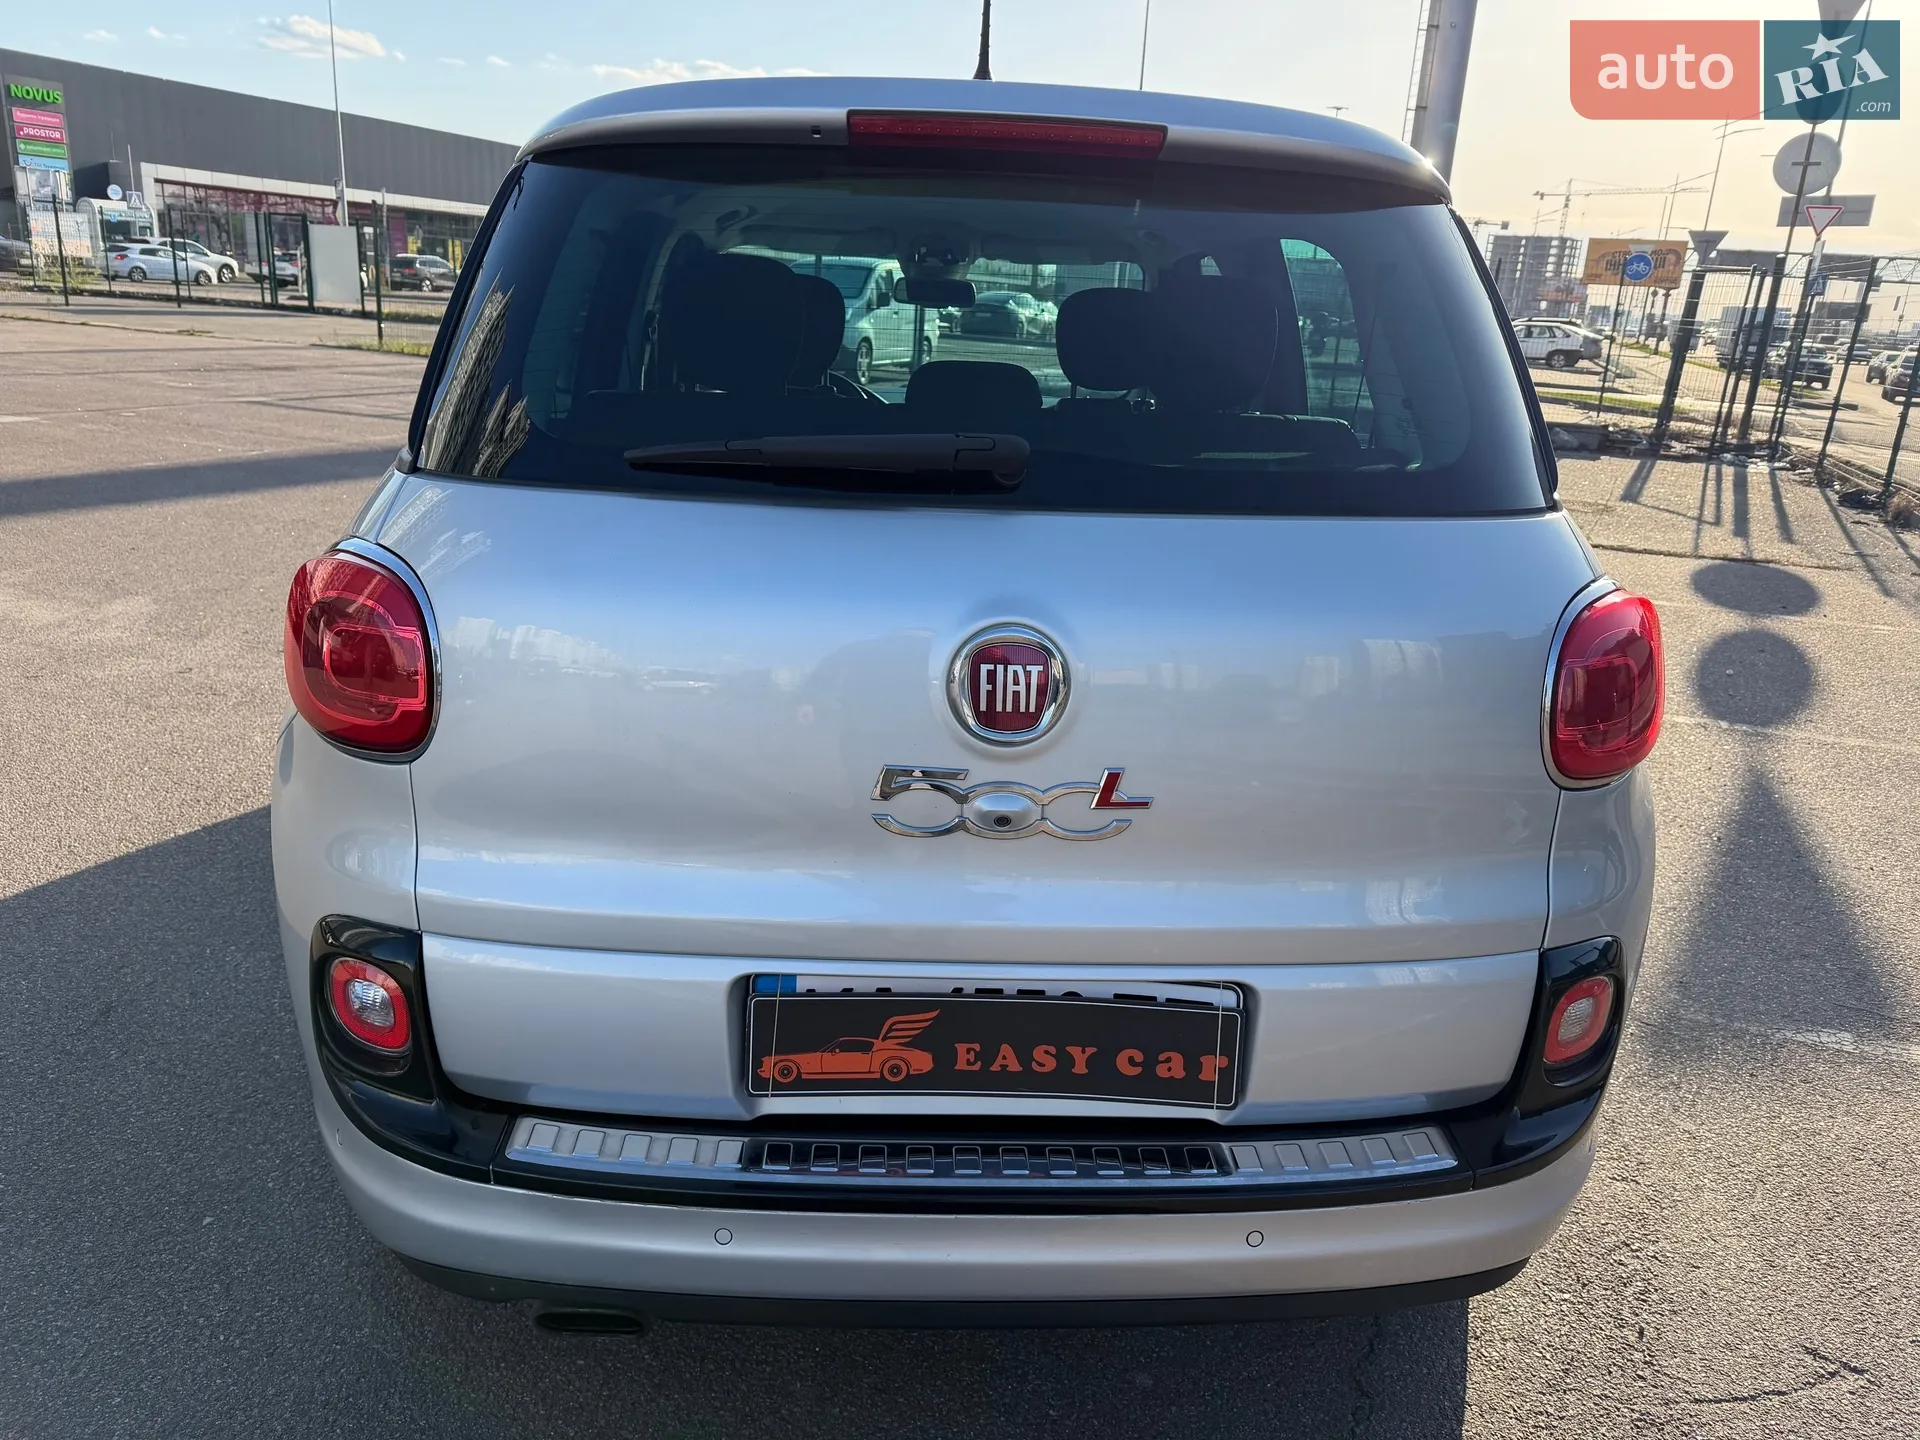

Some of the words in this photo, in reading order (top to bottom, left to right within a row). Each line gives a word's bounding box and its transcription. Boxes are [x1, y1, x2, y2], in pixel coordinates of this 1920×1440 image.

[9, 83, 63, 104] NOVUS
[22, 127, 61, 139] PROSTOR
[979, 663, 1044, 713] FIAT
[954, 1043, 1098, 1075] EASY
[1116, 1048, 1229, 1082] car
